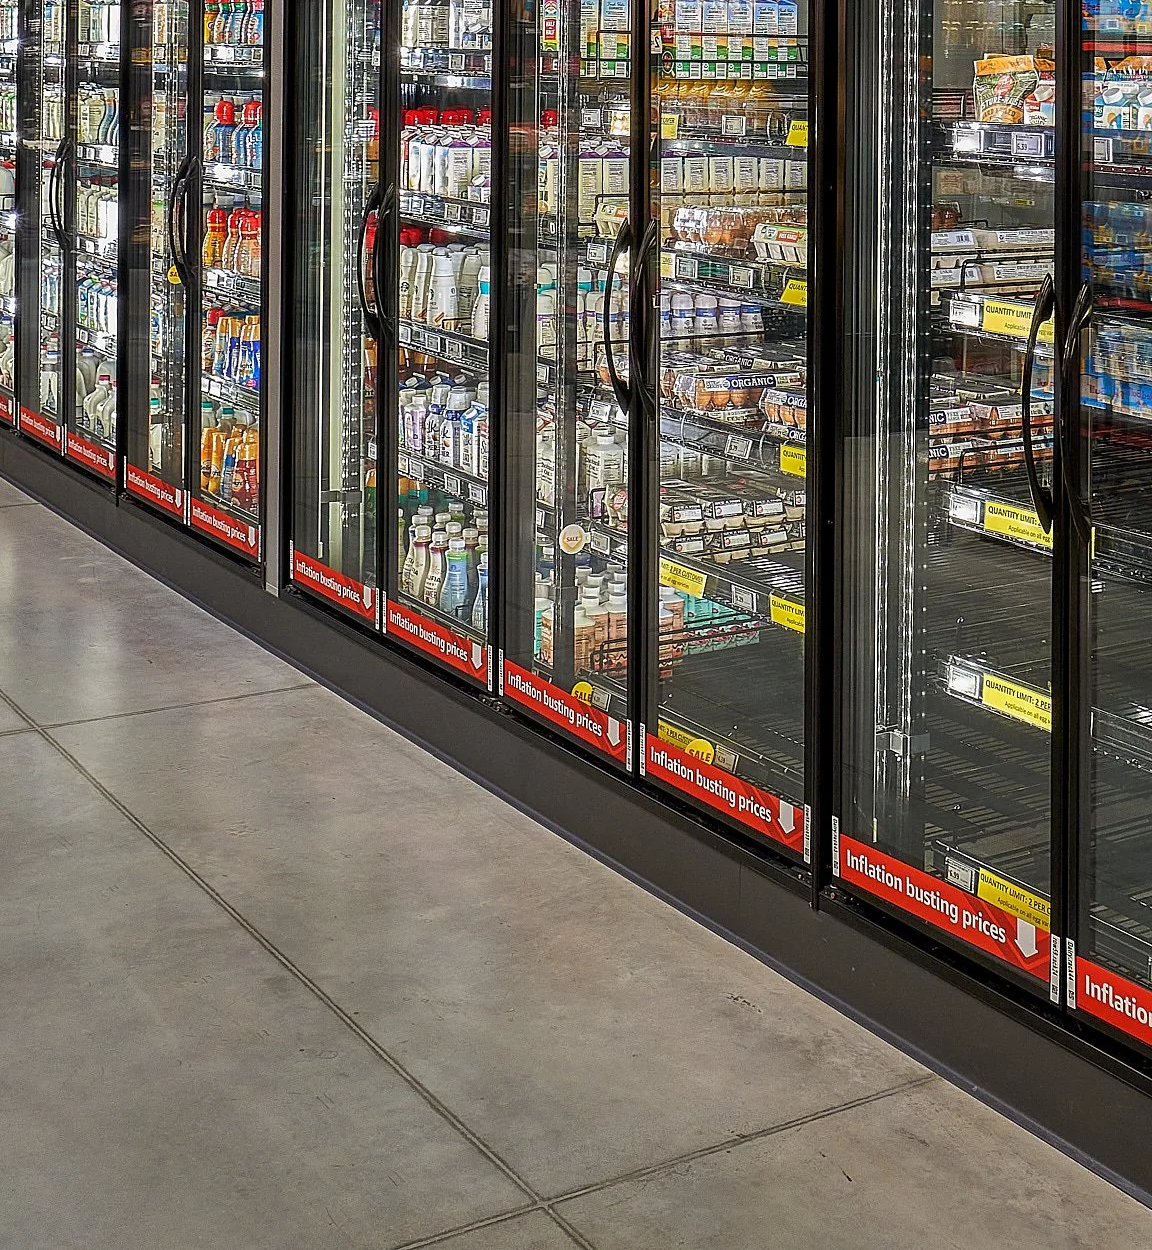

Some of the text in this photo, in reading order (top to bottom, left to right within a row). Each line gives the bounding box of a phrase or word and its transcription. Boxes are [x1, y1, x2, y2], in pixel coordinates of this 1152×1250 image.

[985, 305, 1016, 317] QUANTITY
[725, 354, 753, 367] ORGANIC
[731, 377, 774, 388] ORGANIC
[783, 450, 806, 461] QUANTIT
[988, 505, 1037, 526] QUANTITY LIMIT:
[566, 535, 579, 543] SALE
[296, 559, 361, 603] Inflation busting prices
[771, 599, 795, 613] QUANTITY
[389, 609, 468, 661] Inflation busting prices
[508, 670, 602, 737] Inflation busting prices
[985, 679, 1016, 697] QUANTITY
[1016, 690, 1035, 705] LIMIT:
[1035, 698, 1040, 707] 2
[688, 748, 712, 762] SALE
[650, 746, 772, 823] Inflation busting prices
[846, 848, 1007, 944] Inflation busting prices
[980, 873, 1046, 913] QUANTITY LIMIT: 2 PER
